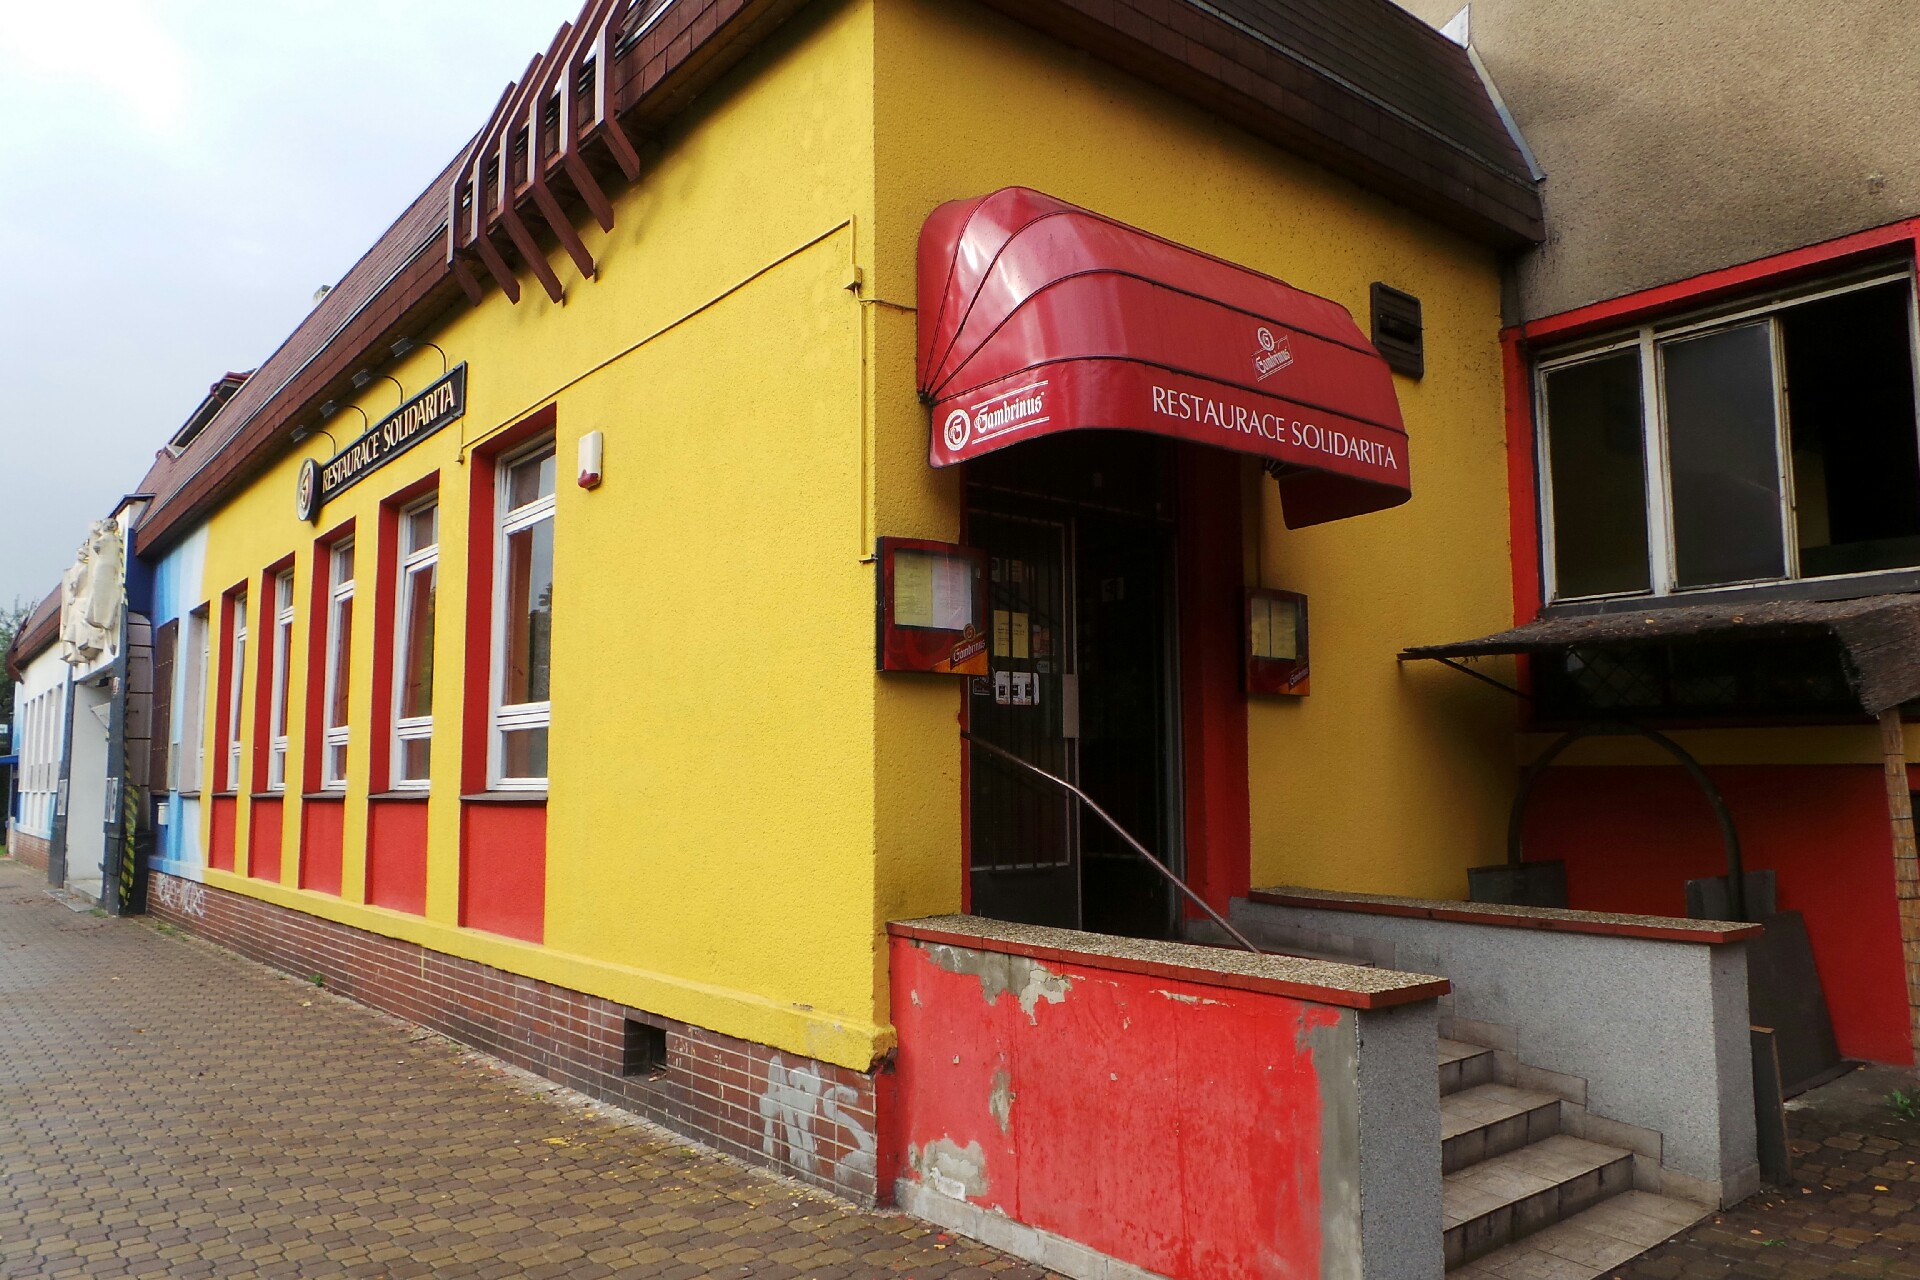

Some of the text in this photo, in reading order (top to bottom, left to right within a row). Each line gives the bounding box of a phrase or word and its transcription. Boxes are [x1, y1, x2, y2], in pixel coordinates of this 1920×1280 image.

[322, 381, 455, 493] RESTAURACE SOLIDARITA
[974, 394, 1043, 434] Gambrinus
[1152, 385, 1398, 470] RESTAURACE SOLIDARITA
